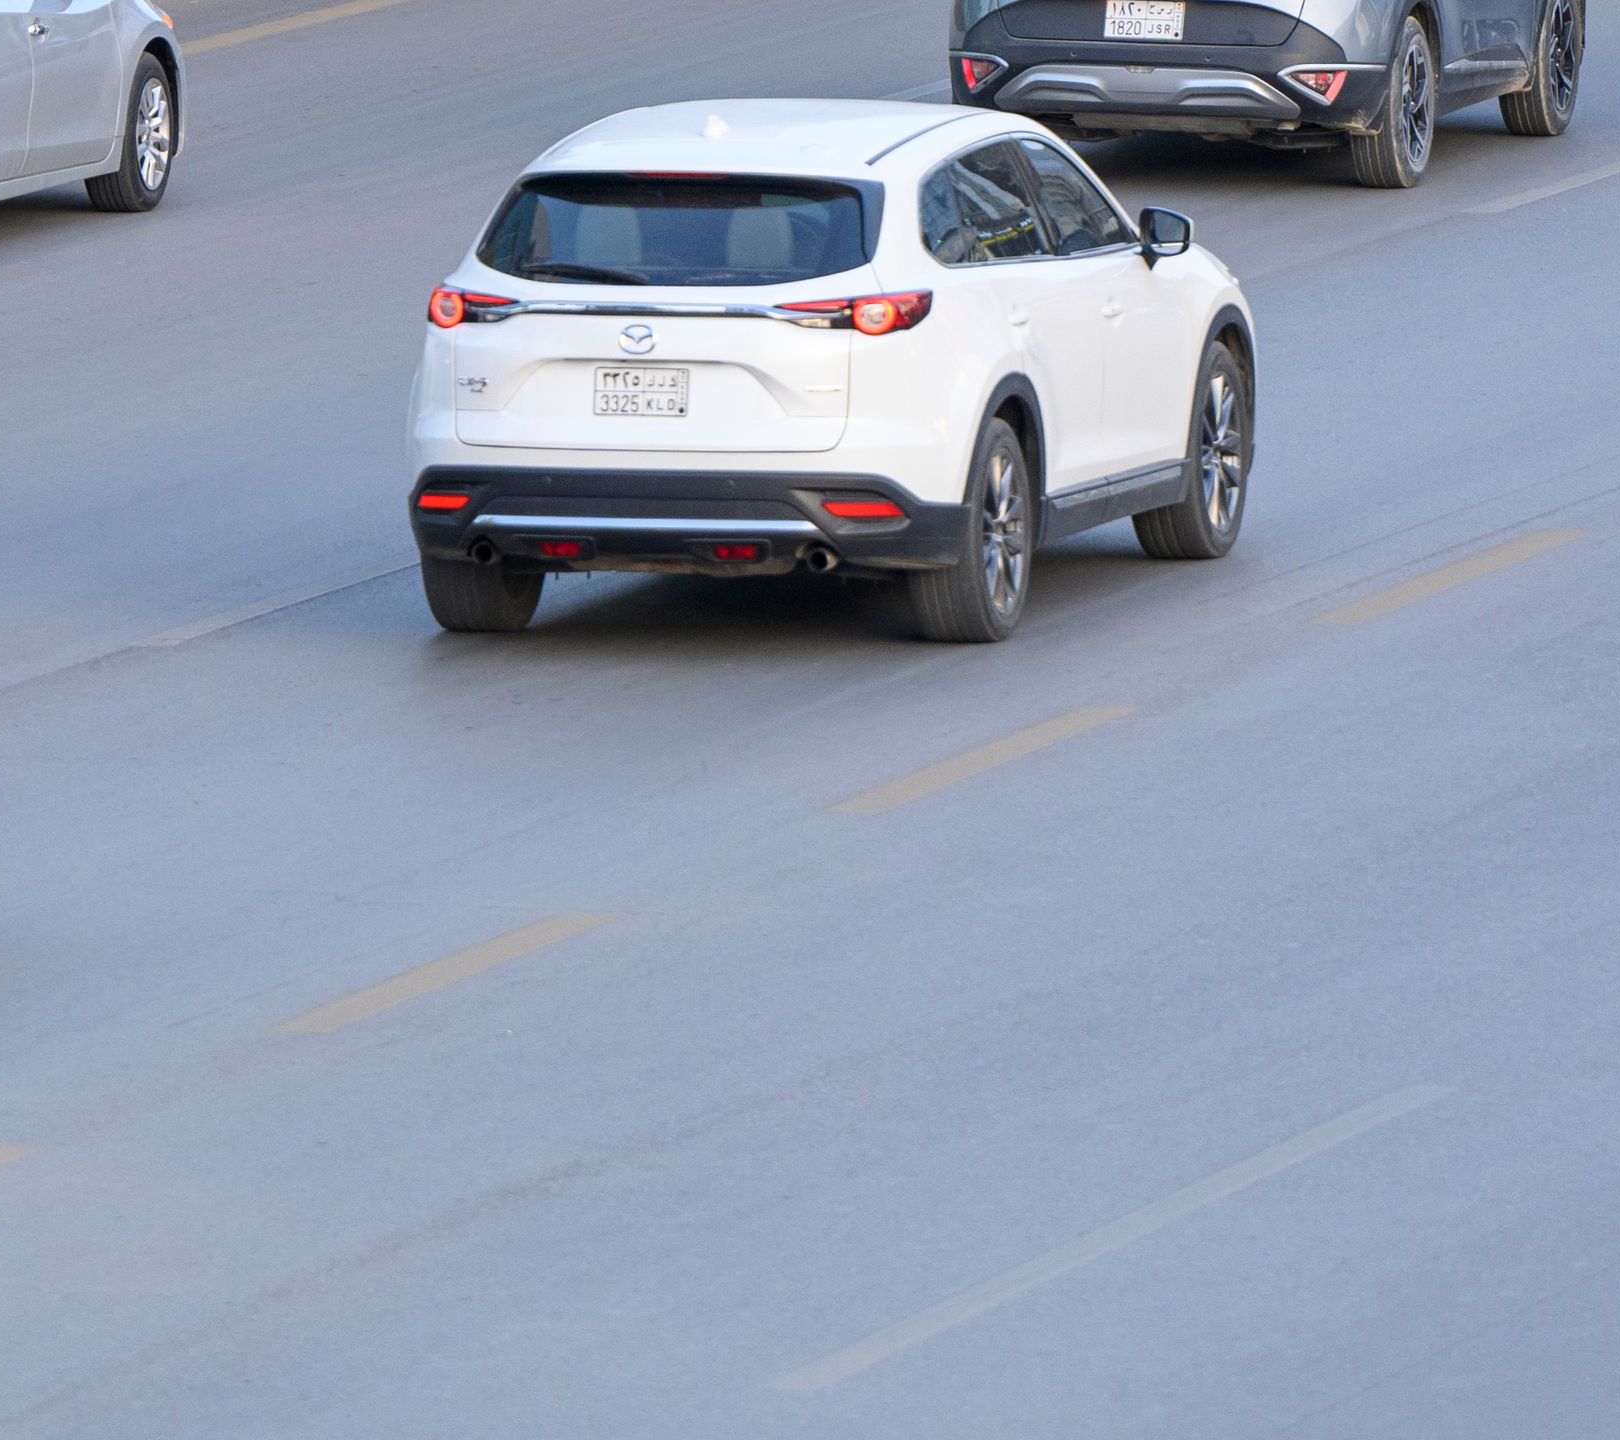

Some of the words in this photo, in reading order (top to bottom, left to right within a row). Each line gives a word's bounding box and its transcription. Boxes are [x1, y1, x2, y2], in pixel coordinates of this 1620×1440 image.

[1110, 20, 1142, 36] 1820
[1147, 23, 1171, 35] JSR
[601, 394, 640, 413] 3325
[647, 398, 676, 412] KLD
